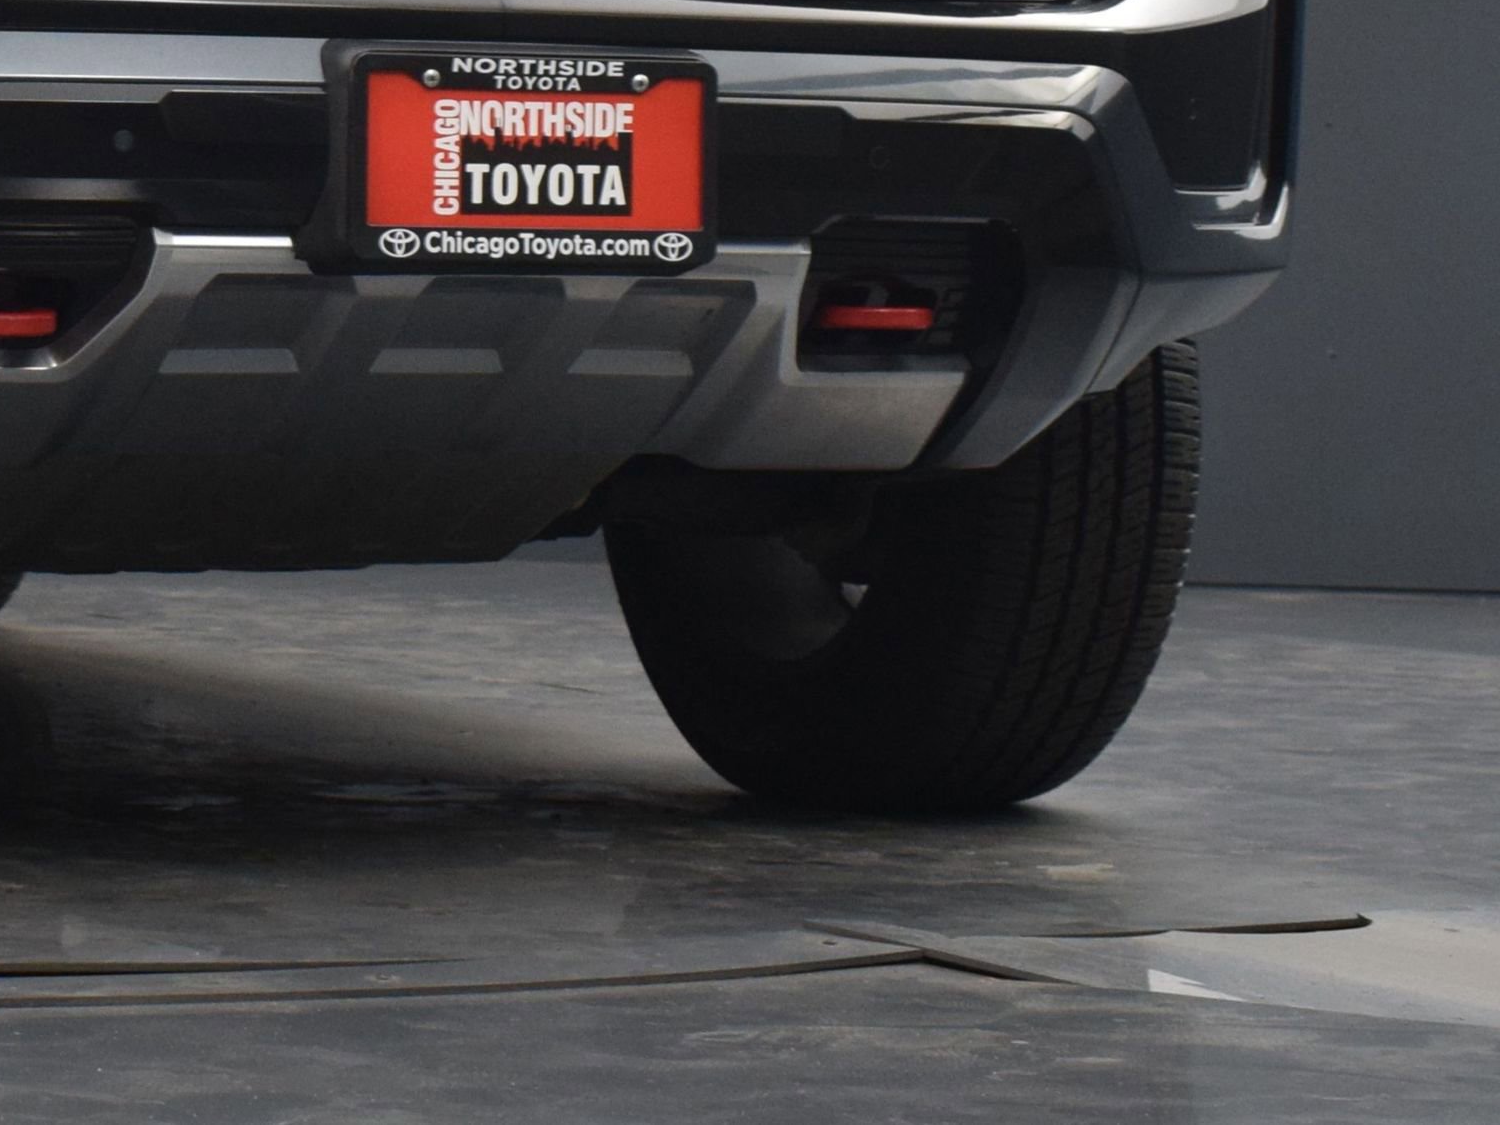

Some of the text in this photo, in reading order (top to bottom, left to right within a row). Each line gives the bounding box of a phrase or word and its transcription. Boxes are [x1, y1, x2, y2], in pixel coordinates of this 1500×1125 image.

[452, 57, 624, 77] NORTHSIDE
[494, 75, 581, 91] TOYOTA
[460, 100, 634, 138] NORTHSIDE
[433, 99, 460, 216] CHICAGO
[466, 163, 626, 206] TOYOTA
[424, 231, 650, 258] ChicagoToyota.com
